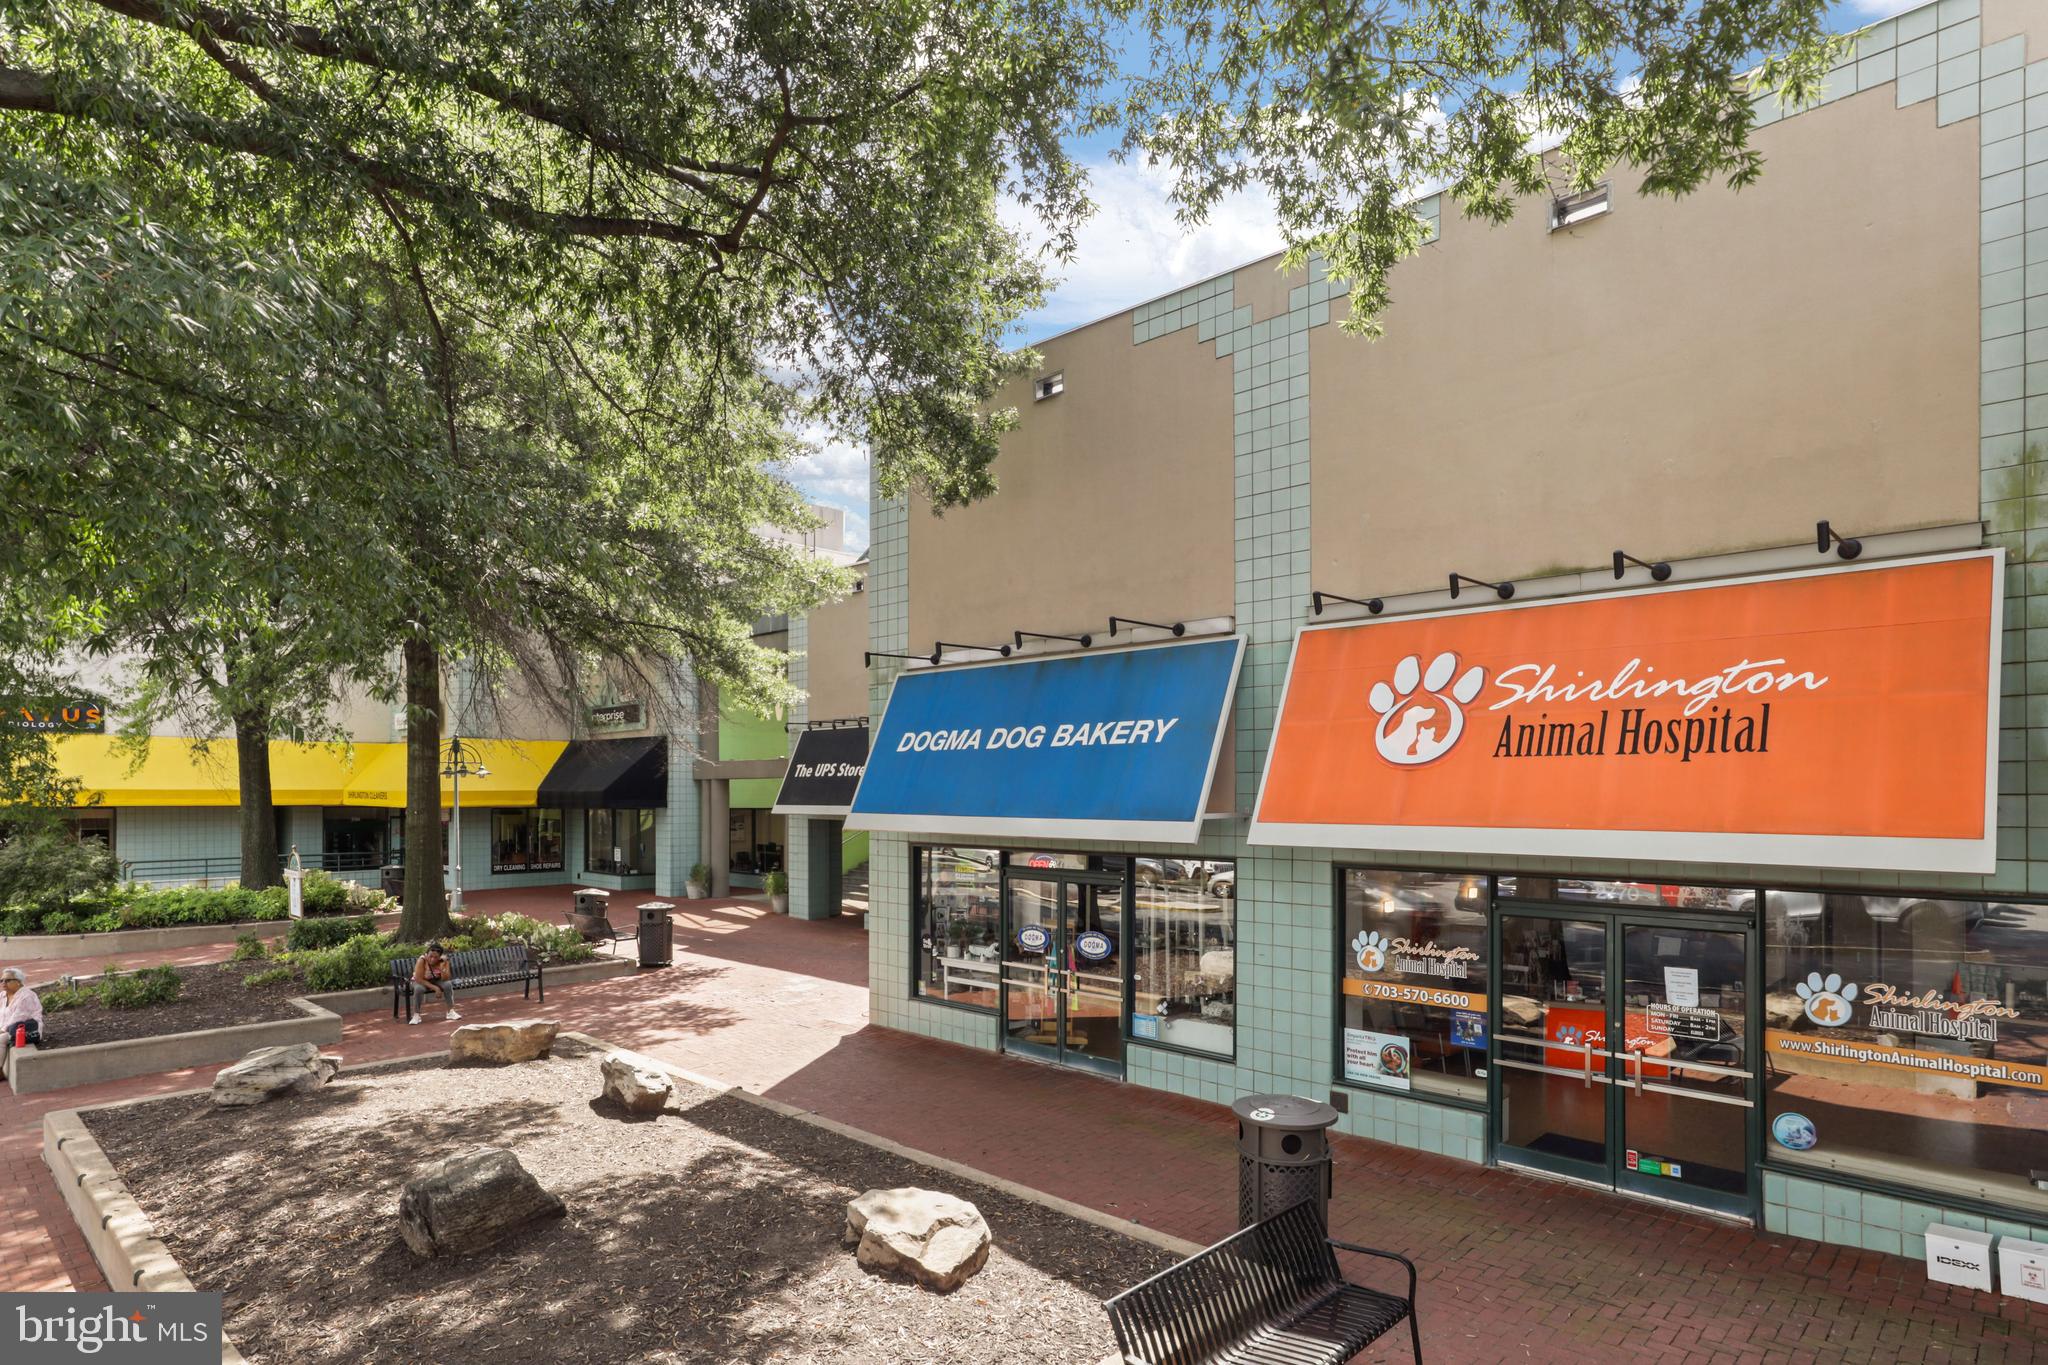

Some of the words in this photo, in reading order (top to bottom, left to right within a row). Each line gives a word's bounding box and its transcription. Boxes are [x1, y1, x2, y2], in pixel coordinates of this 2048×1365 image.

[1489, 658, 1829, 716] Shirlington
[896, 728, 982, 752] DOGMA
[986, 725, 1047, 750] DOG
[1050, 717, 1179, 748] BAKERY
[1492, 708, 1609, 758] Animal
[1617, 703, 1771, 761] Hospital
[794, 763, 813, 777] The
[814, 762, 837, 777] UPS
[837, 762, 866, 777] Store
[1390, 937, 1480, 964] Shirlington
[1394, 954, 1428, 975] Animal
[1427, 957, 1468, 980] Hospital
[1373, 983, 1470, 1008] 703-570-6600
[1864, 983, 2021, 1021] Shirlington
[1650, 1002, 1671, 1012] HOURS
[1680, 1006, 1716, 1017] OPERATION
[1650, 1017, 1681, 1027] SATURDAY
[1650, 1024, 1675, 1032] SUNDAY
[1869, 1005, 1927, 1033] Animal
[1928, 1010, 1999, 1042] Hospital
[1346, 1047, 1366, 1055] Protect
[1778, 1038, 2043, 1085] www.ShirlingtonAnimalHospital.com
[1359, 1060, 1376, 1068] heart.
[1936, 1255, 1981, 1271] IDEXX
